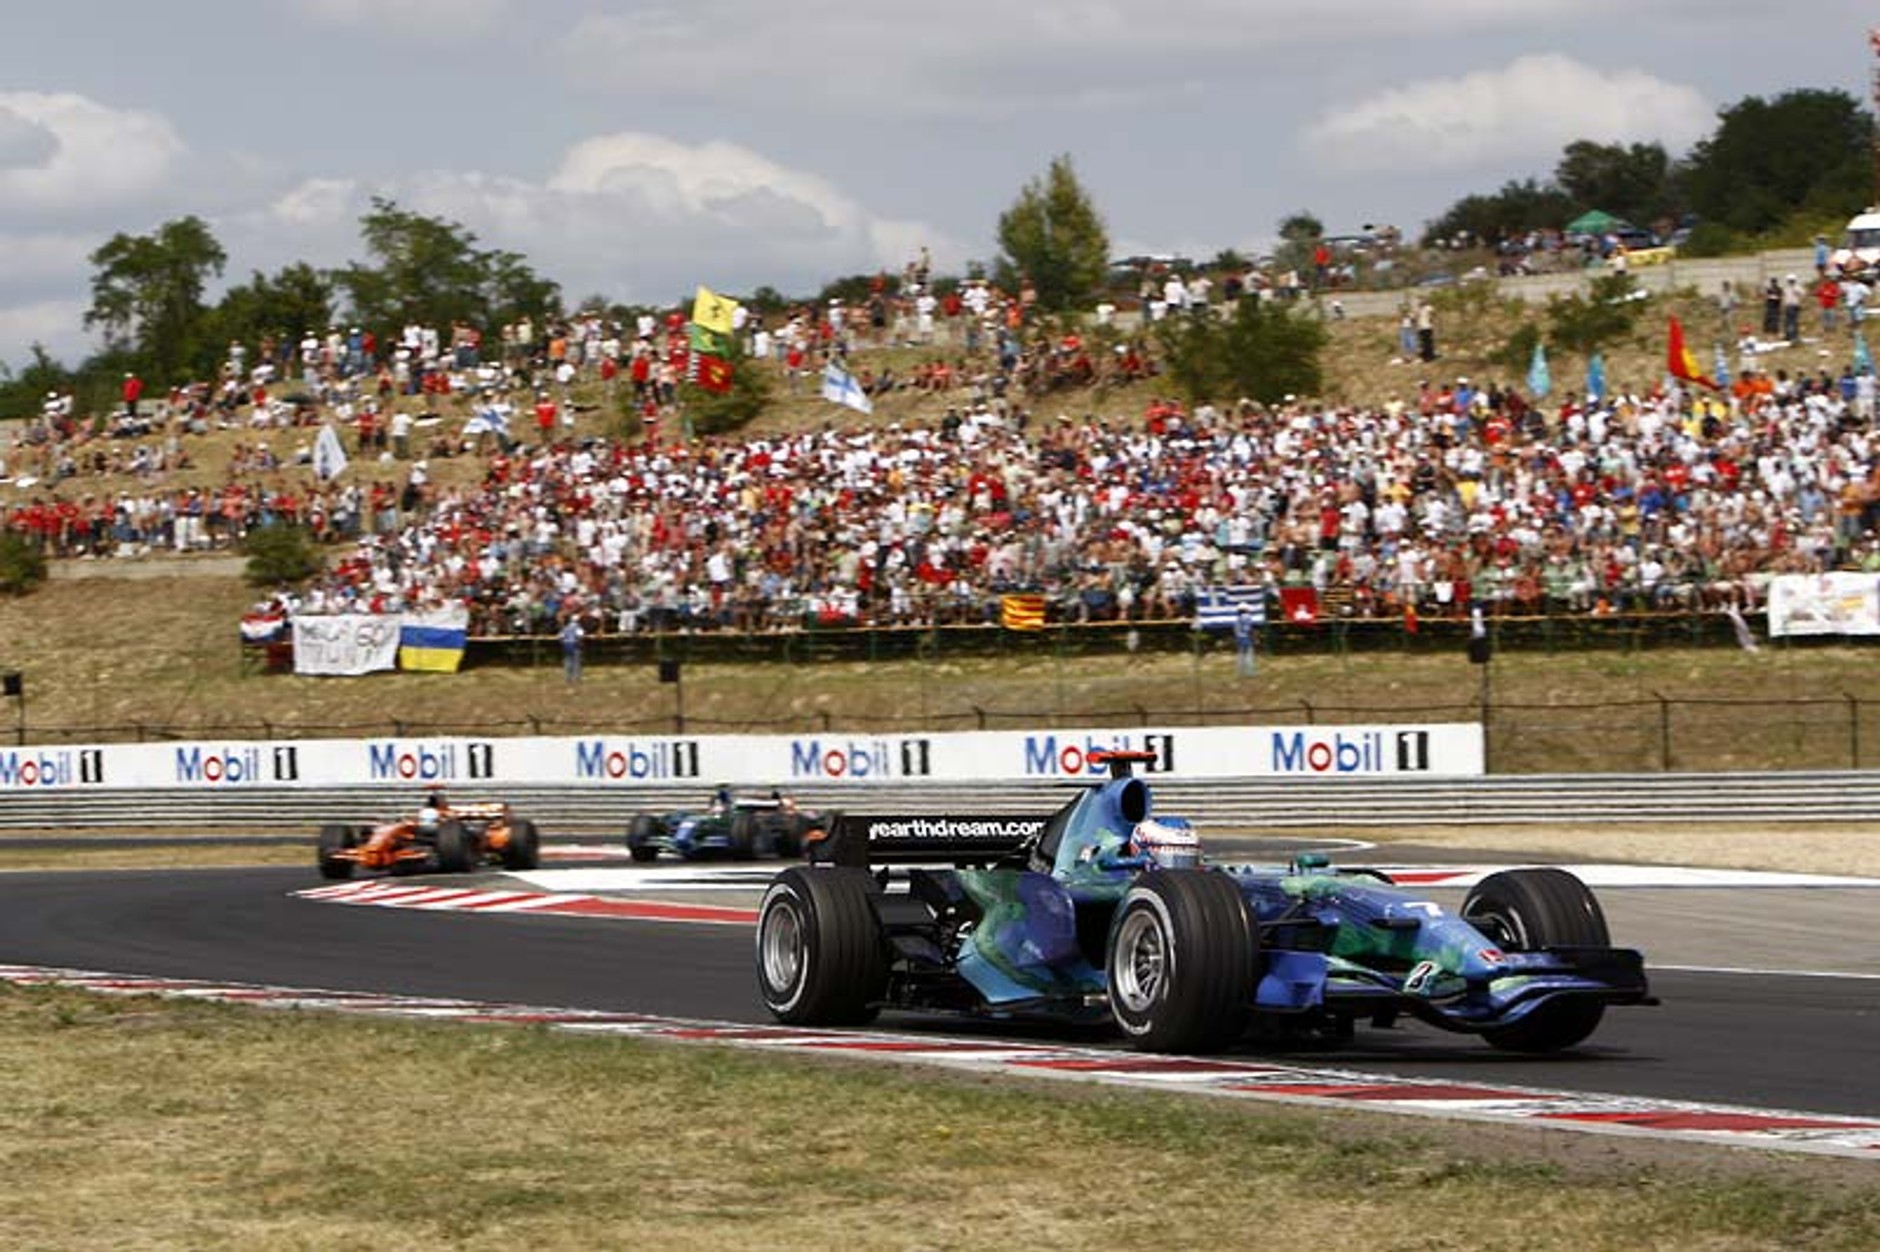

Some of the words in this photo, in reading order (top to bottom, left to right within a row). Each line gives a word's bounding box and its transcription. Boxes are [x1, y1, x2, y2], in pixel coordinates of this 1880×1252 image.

[0, 752, 71, 785] Mobil
[80, 749, 103, 783] 1
[176, 748, 260, 783] Mobil
[274, 746, 298, 781] 1
[369, 744, 456, 780] Mobil
[468, 743, 494, 779] 1
[576, 742, 668, 779] Mobil
[673, 741, 700, 778] 1
[792, 741, 891, 777] Mobil
[901, 739, 930, 777] 1
[1144, 734, 1174, 773] 1
[1272, 732, 1381, 773] Mobil
[1397, 730, 1429, 772] 1
